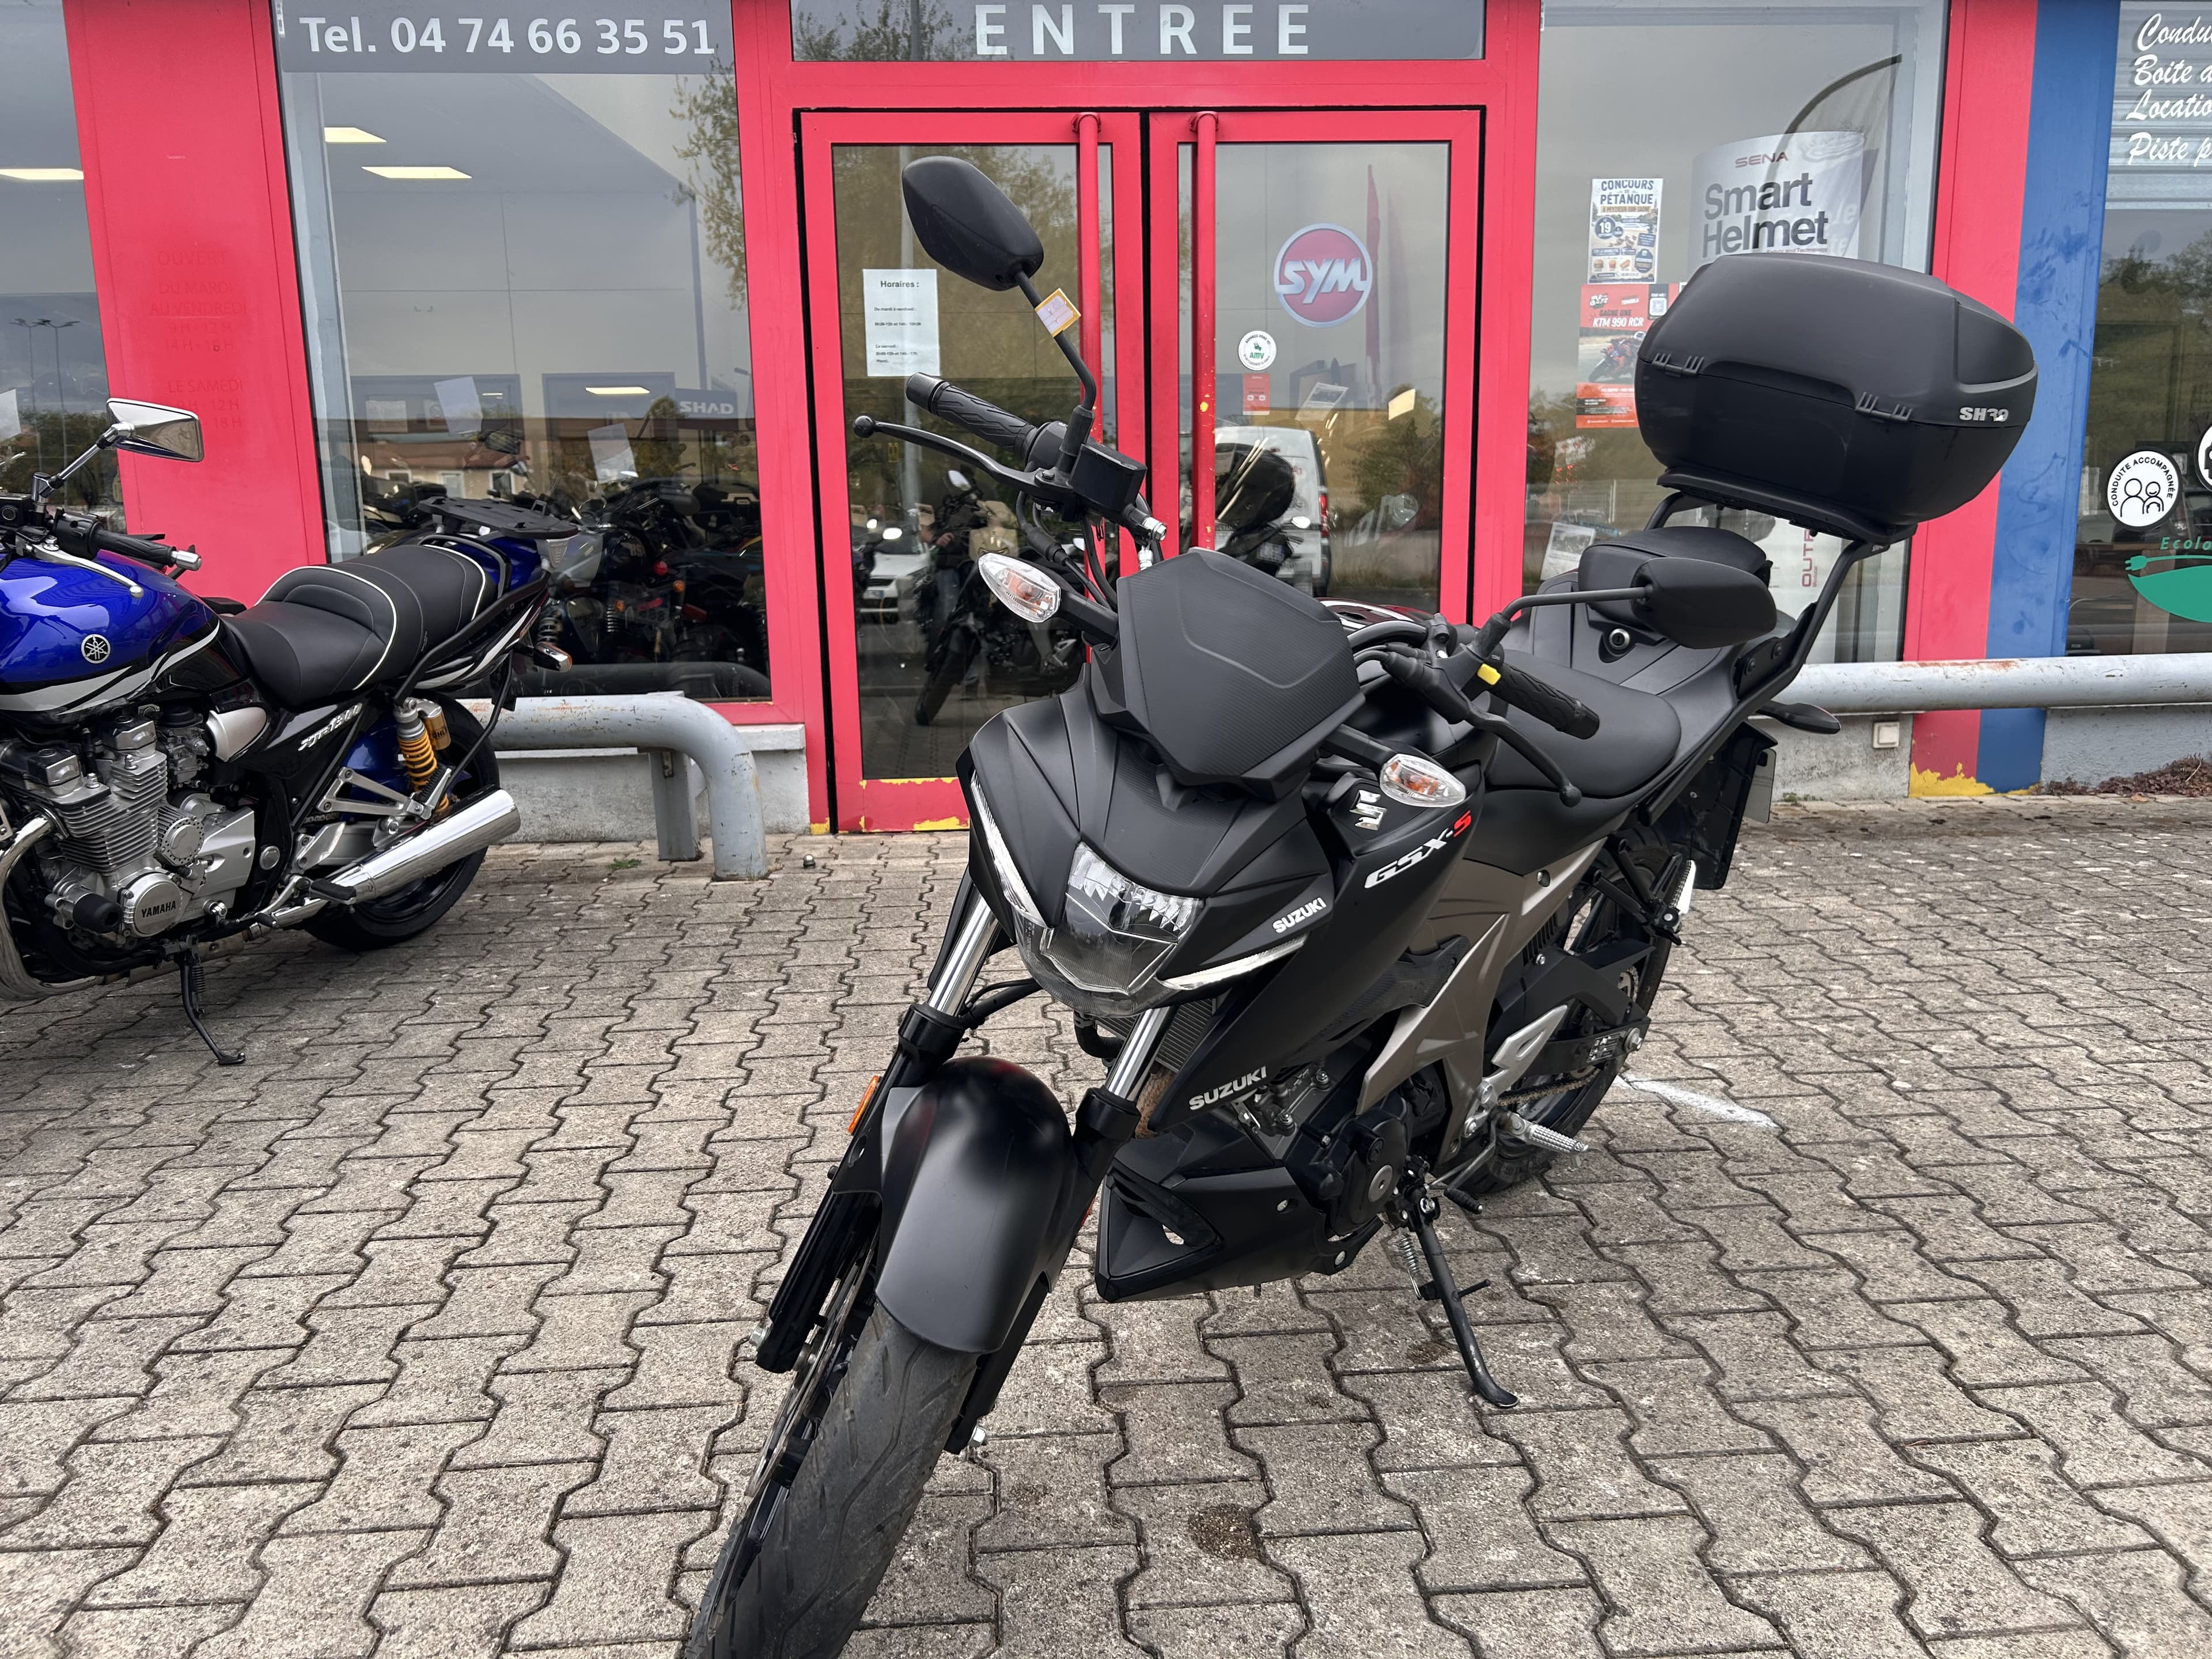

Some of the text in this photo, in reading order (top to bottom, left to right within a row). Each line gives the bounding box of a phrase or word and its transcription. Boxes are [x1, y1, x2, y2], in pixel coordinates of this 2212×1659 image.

[299, 17, 715, 54] Tel. 04 74 66 35 51
[976, 4, 1309, 55] ENTREE
[2134, 54, 2193, 85] Boite
[2126, 88, 2212, 120] Locatio
[1735, 152, 1789, 168] SENA
[2128, 131, 2189, 166] Piste
[1600, 192, 1653, 205] PÉTANQUE
[1601, 180, 1654, 191] CONCOURS
[1705, 173, 1813, 219] Smart
[1599, 222, 1612, 234] 19
[1703, 211, 1828, 258] Helmet
[1277, 258, 1368, 305] SYM
[1592, 317, 1611, 327] KTM
[1611, 317, 1628, 327] 990
[680, 401, 734, 415] SHAD
[2111, 457, 2176, 506] CONDUITE ACCOMPAGNÉE
[1364, 810, 1472, 889] GSX-S
[141, 900, 176, 918] YAMAHA
[1272, 897, 1327, 933] SUZUKI
[1188, 1066, 1267, 1111] SUZUKI
